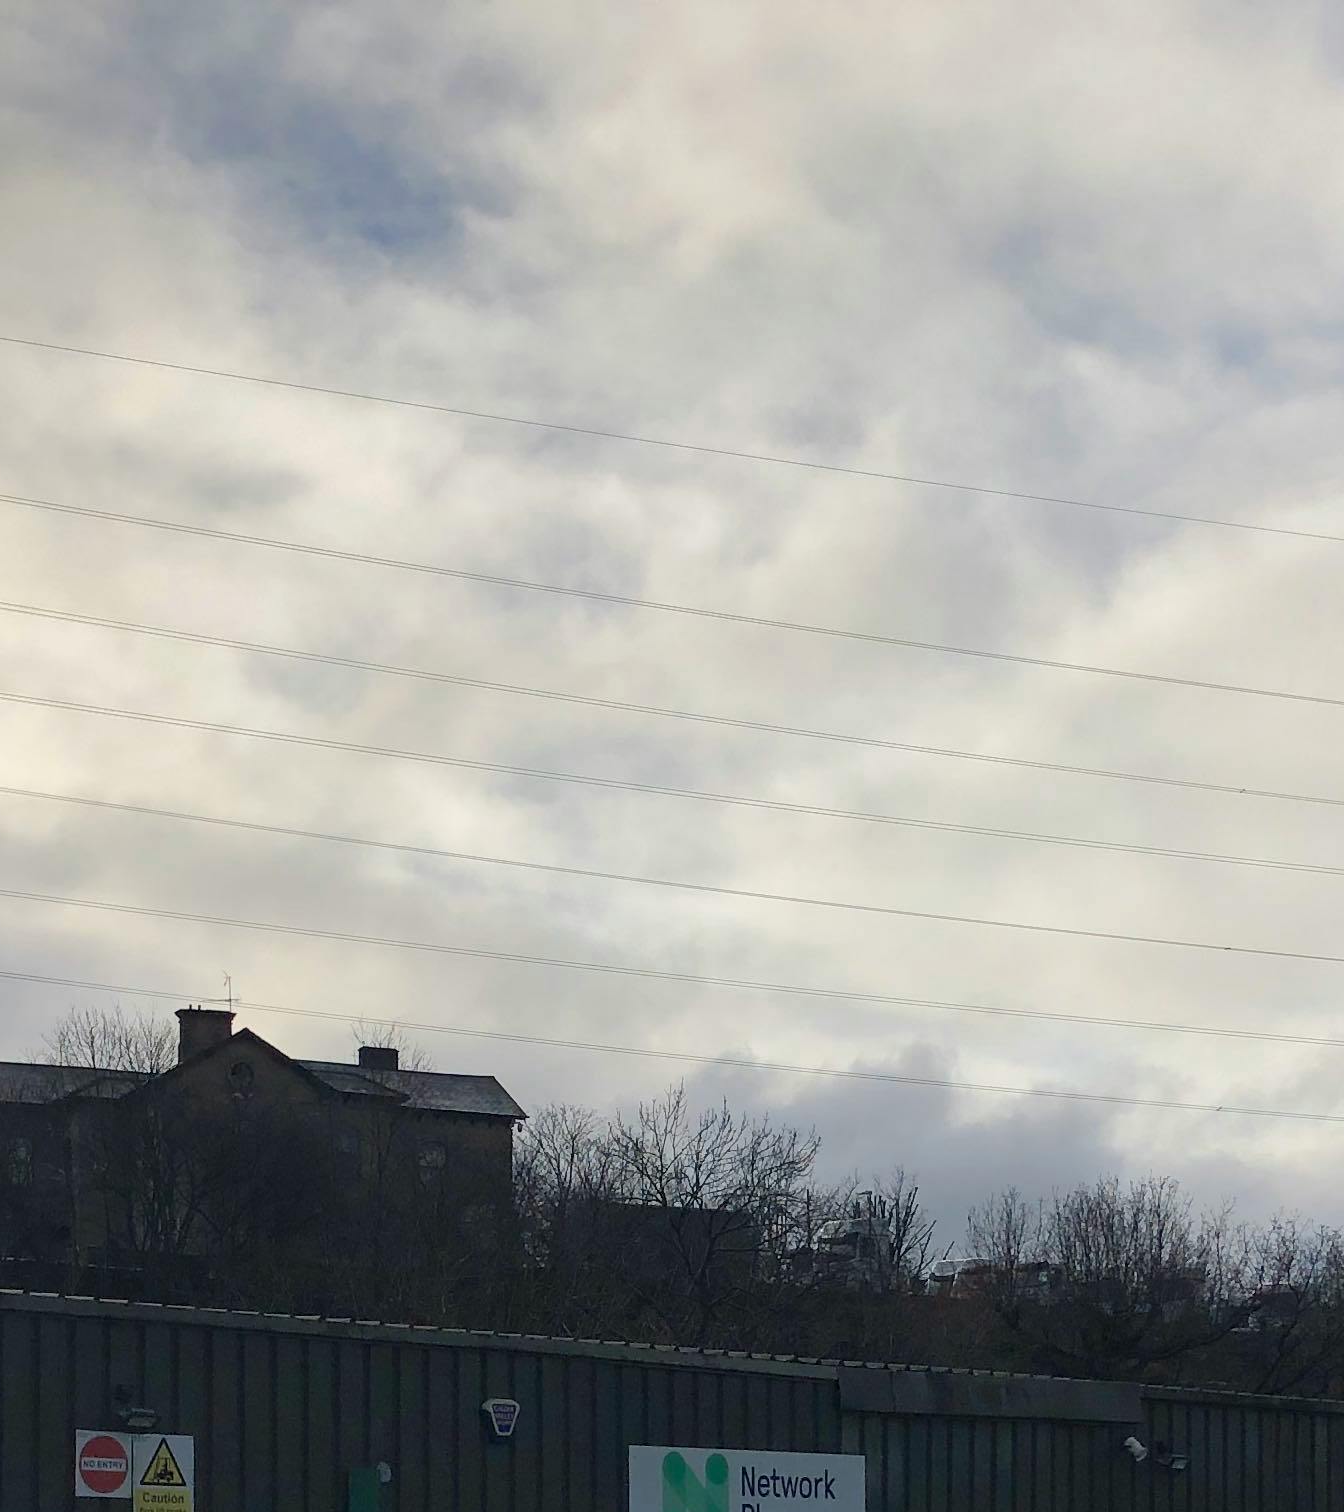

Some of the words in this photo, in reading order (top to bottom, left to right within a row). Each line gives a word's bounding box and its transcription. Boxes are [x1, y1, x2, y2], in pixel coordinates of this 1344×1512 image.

[83, 1460, 96, 1468] NO
[97, 1461, 124, 1469] ENTRY
[741, 1466, 836, 1499] Network
[143, 1492, 184, 1503] Caution
